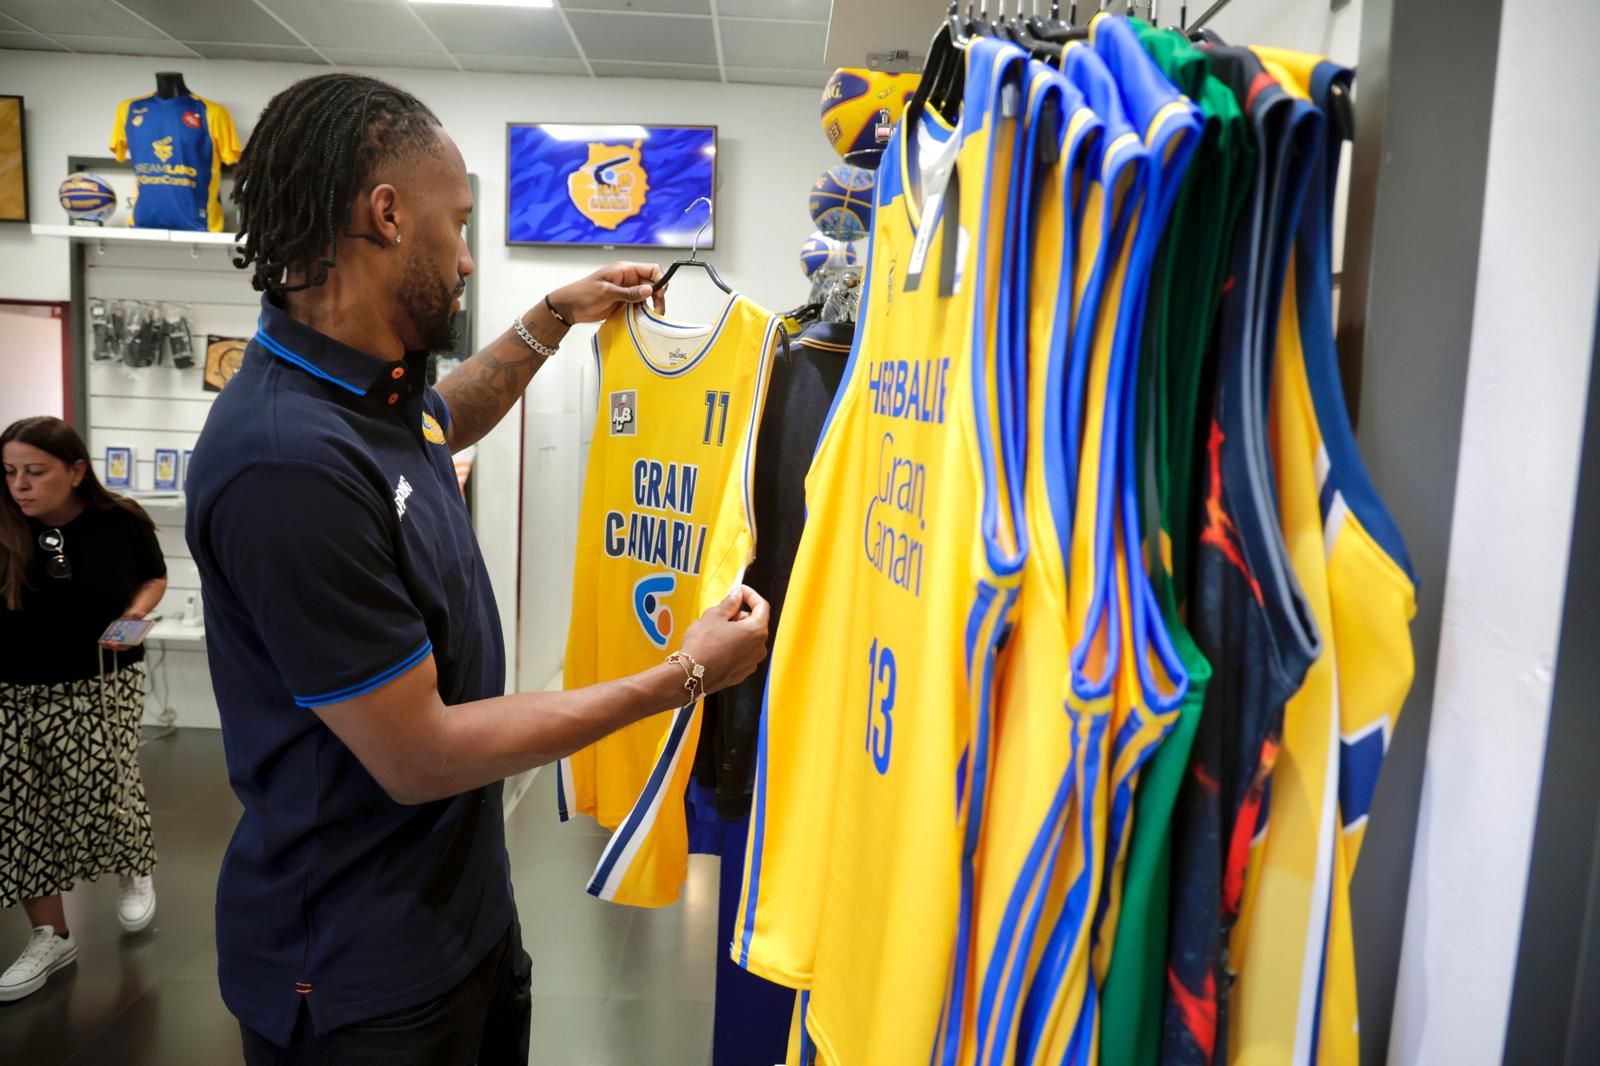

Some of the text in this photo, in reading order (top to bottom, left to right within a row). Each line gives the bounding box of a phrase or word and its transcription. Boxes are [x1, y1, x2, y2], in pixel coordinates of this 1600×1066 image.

[703, 390, 731, 446] 11
[633, 458, 698, 515] GRAN
[878, 431, 926, 519] Gran
[865, 636, 897, 776] 13
